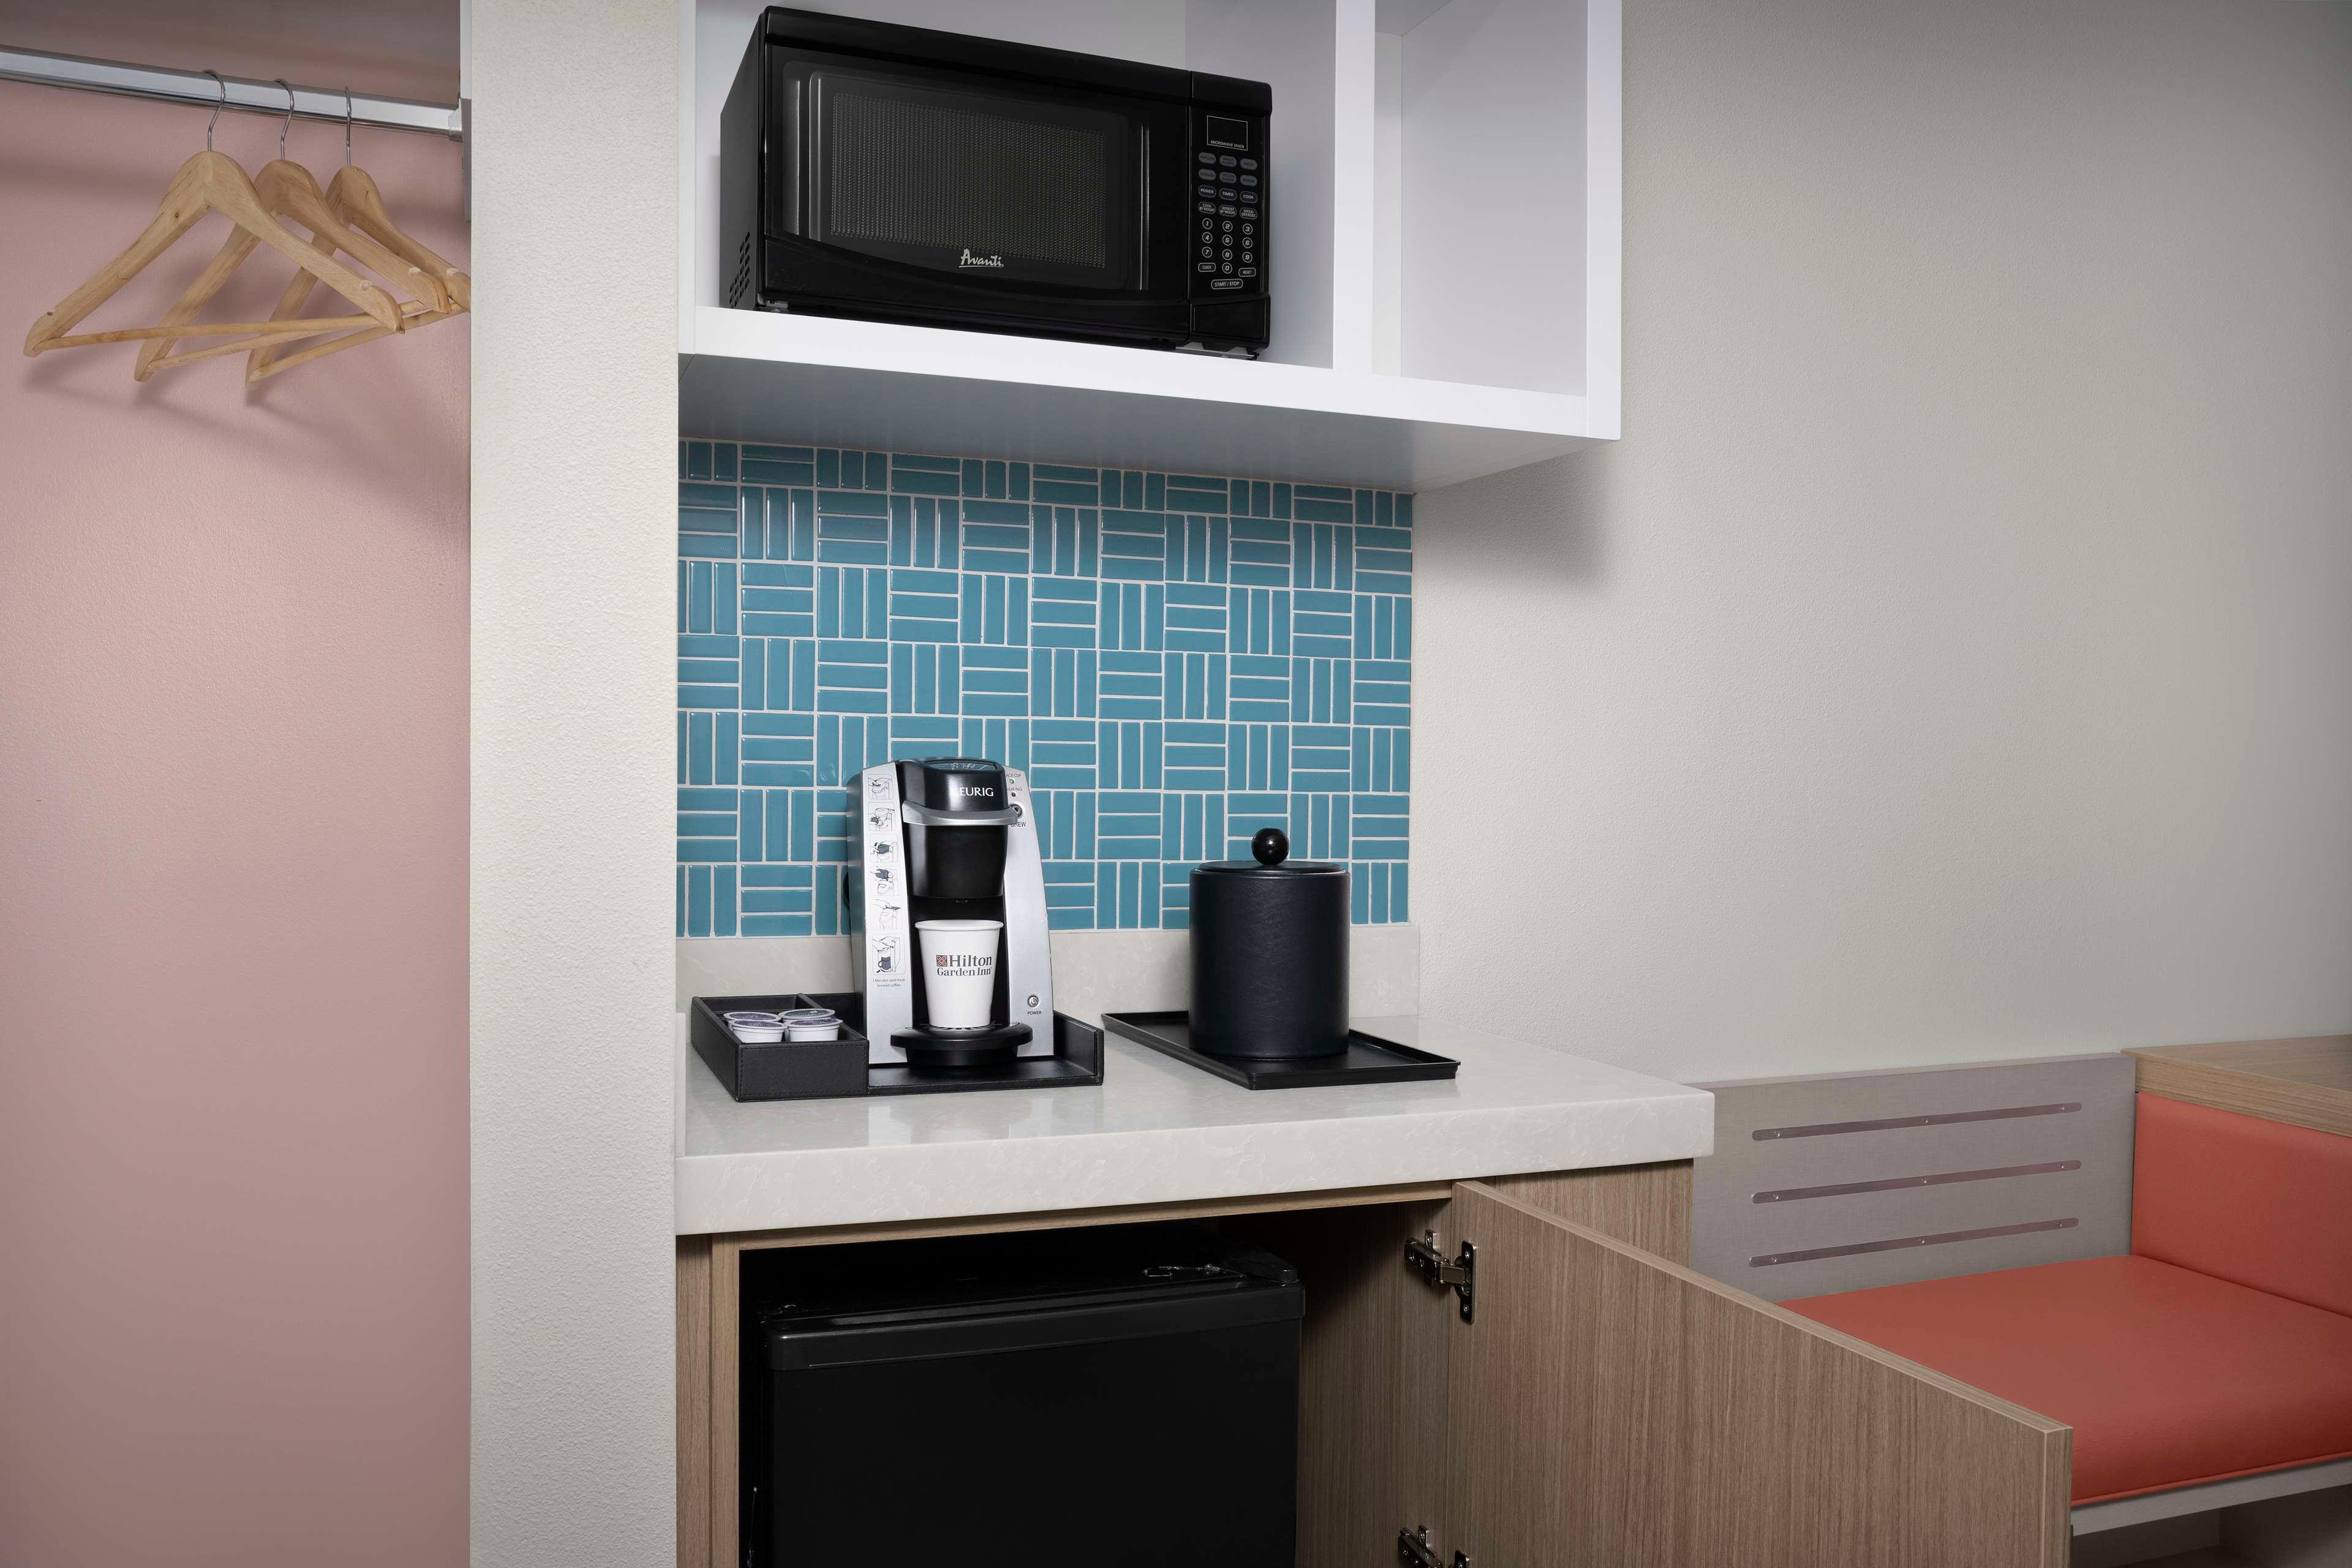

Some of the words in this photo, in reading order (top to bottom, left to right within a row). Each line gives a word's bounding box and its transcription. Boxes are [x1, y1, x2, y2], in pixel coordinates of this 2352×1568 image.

[960, 249, 1004, 267] Avanti
[956, 787, 994, 796] EURIG
[949, 955, 992, 967] Hilton
[937, 967, 975, 976] Garden
[977, 967, 991, 976] Inn
